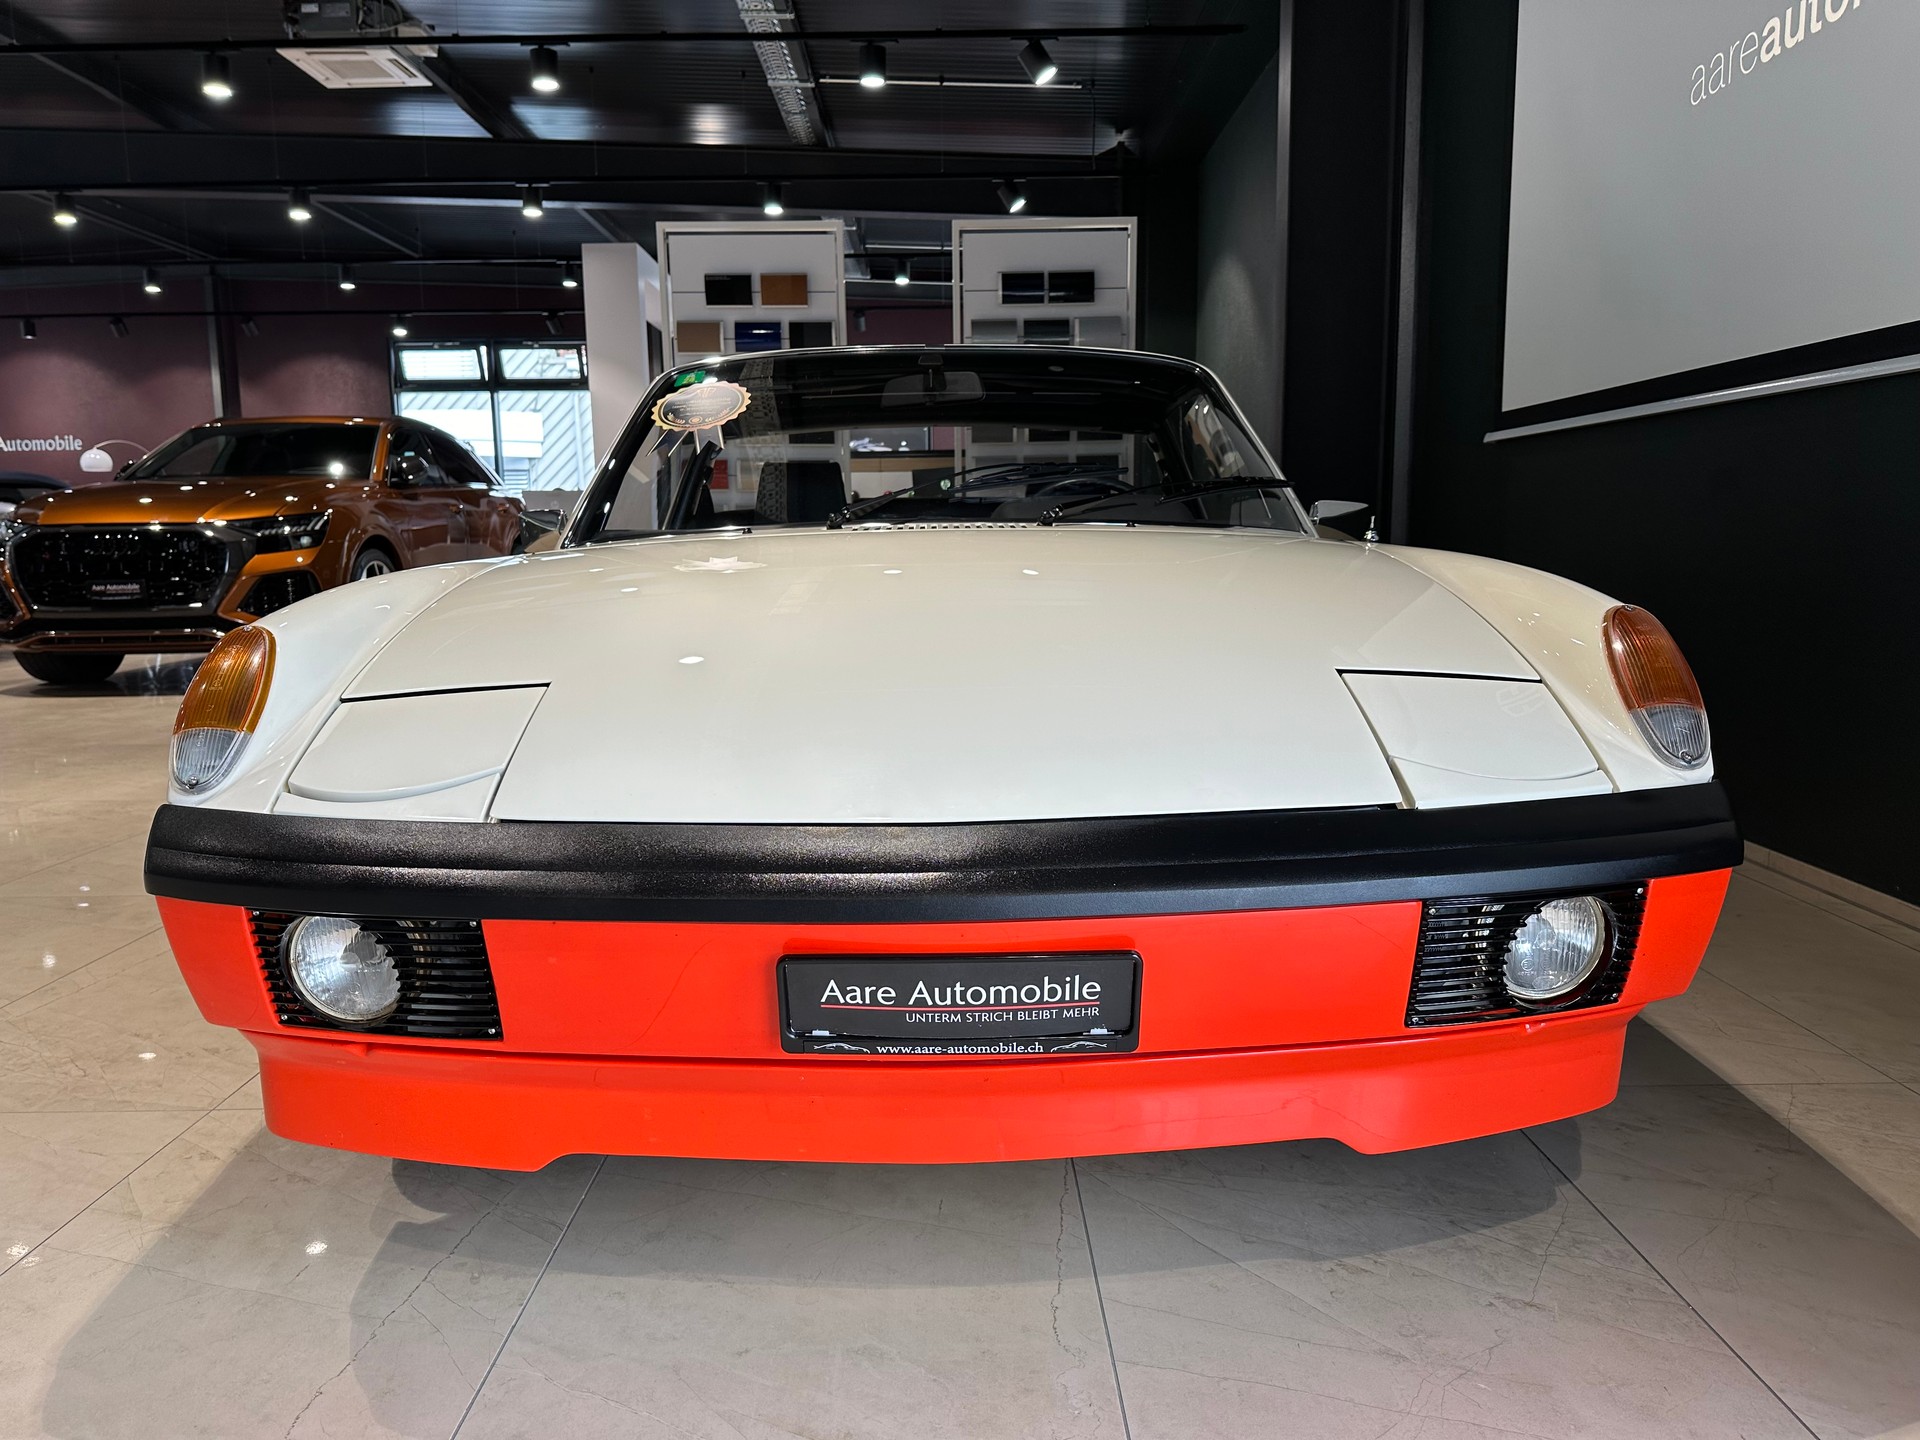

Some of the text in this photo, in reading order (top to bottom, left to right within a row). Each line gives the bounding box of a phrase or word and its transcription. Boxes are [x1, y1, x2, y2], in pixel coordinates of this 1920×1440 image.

[820, 974, 1101, 1006] Aare Automobile
[906, 1007, 1100, 1023] UNTERM STRICH BLEIBT MEHR
[876, 1041, 1044, 1055] www.aare-automobile.ch
